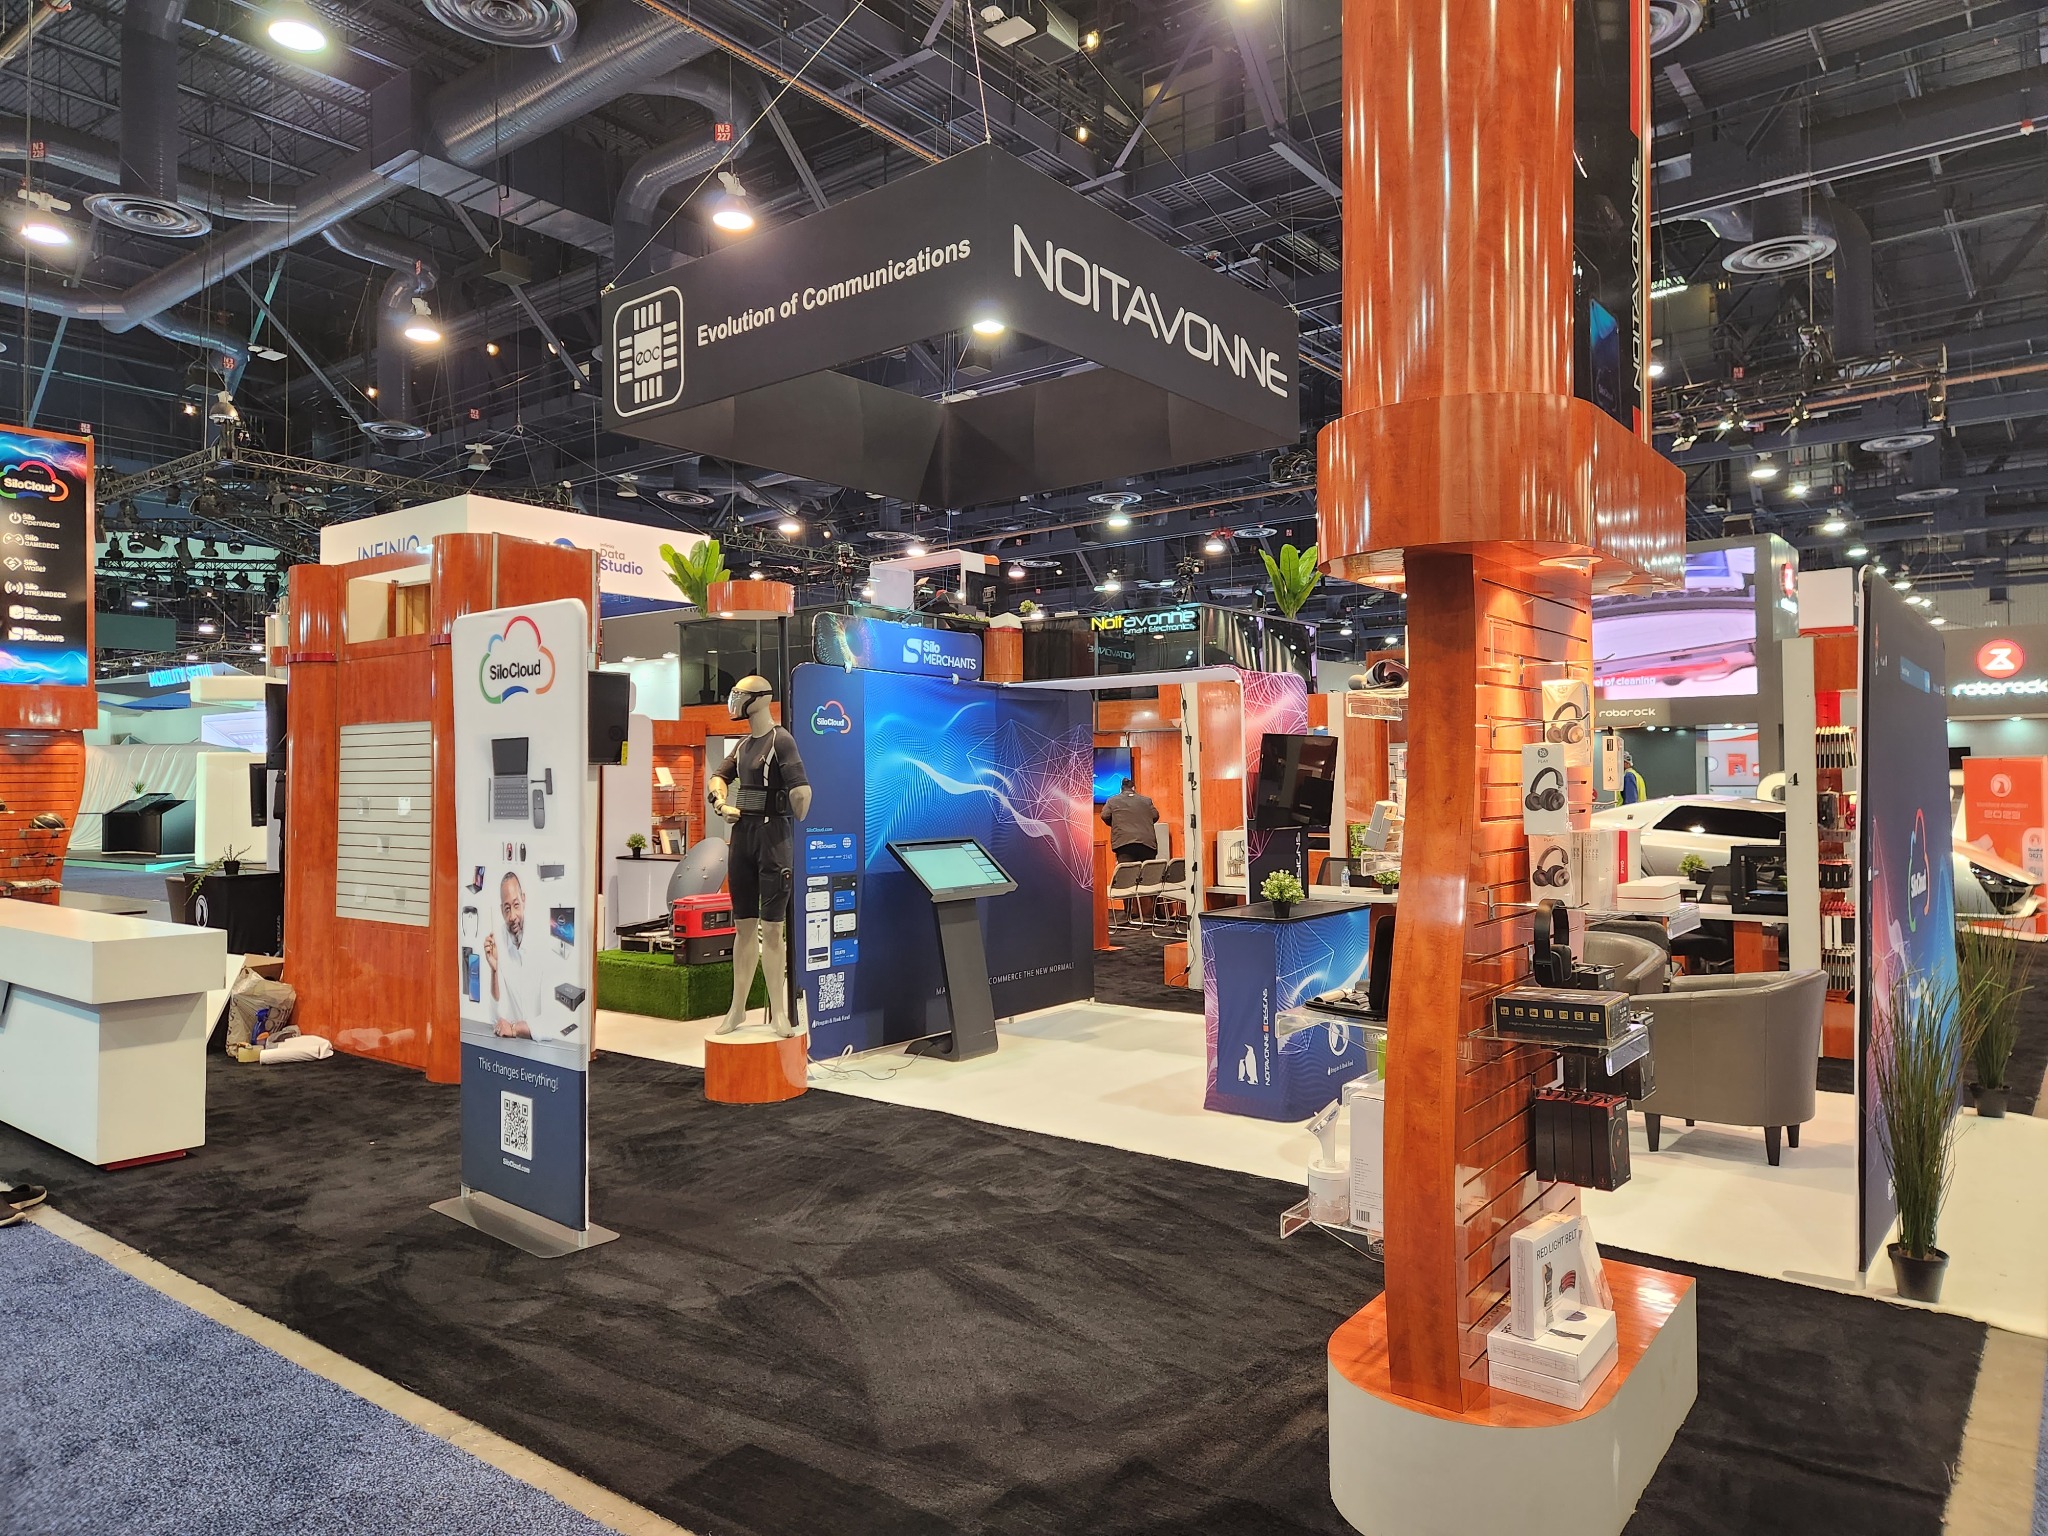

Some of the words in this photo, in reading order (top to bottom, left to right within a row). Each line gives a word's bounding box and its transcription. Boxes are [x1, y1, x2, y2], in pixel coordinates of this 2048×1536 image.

[717, 124, 730, 132] N3
[1631, 157, 1642, 391] NOITAVONNE
[697, 306, 775, 347] Evolution
[779, 293, 799, 318] of
[802, 239, 971, 310] Communications
[1014, 224, 1288, 398] NOITAVONNE
[4, 477, 56, 493] SiloCloud
[600, 548, 625, 560] Data
[24, 565, 46, 573] Wallet
[600, 559, 643, 575] Studio
[1091, 610, 1195, 630] Noitavonne
[1123, 627, 1147, 635] Smart
[1148, 623, 1196, 633] Electronics
[923, 640, 940, 653] Silo
[490, 659, 540, 680] SiloCloud
[923, 653, 977, 670] MERCHANTS
[148, 667, 187, 687] MOBILITY
[1605, 678, 1615, 686] of
[1616, 676, 1656, 685] cleaning
[1952, 679, 2048, 697] roborock
[1599, 708, 1656, 717] roborock
[816, 717, 845, 726] SiloCloud
[1788, 772, 1799, 786] 4
[988, 971, 1022, 985] COMMERCE
[1023, 970, 1034, 978] THE
[1035, 966, 1048, 976] NEW
[478, 1056, 491, 1073] This
[492, 1061, 519, 1081] changes
[520, 1067, 559, 1093] Everything!
[1536, 1246, 1548, 1260] RED
[1548, 1236, 1564, 1255] LIGHT
[1565, 1228, 1577, 1244] BELT
